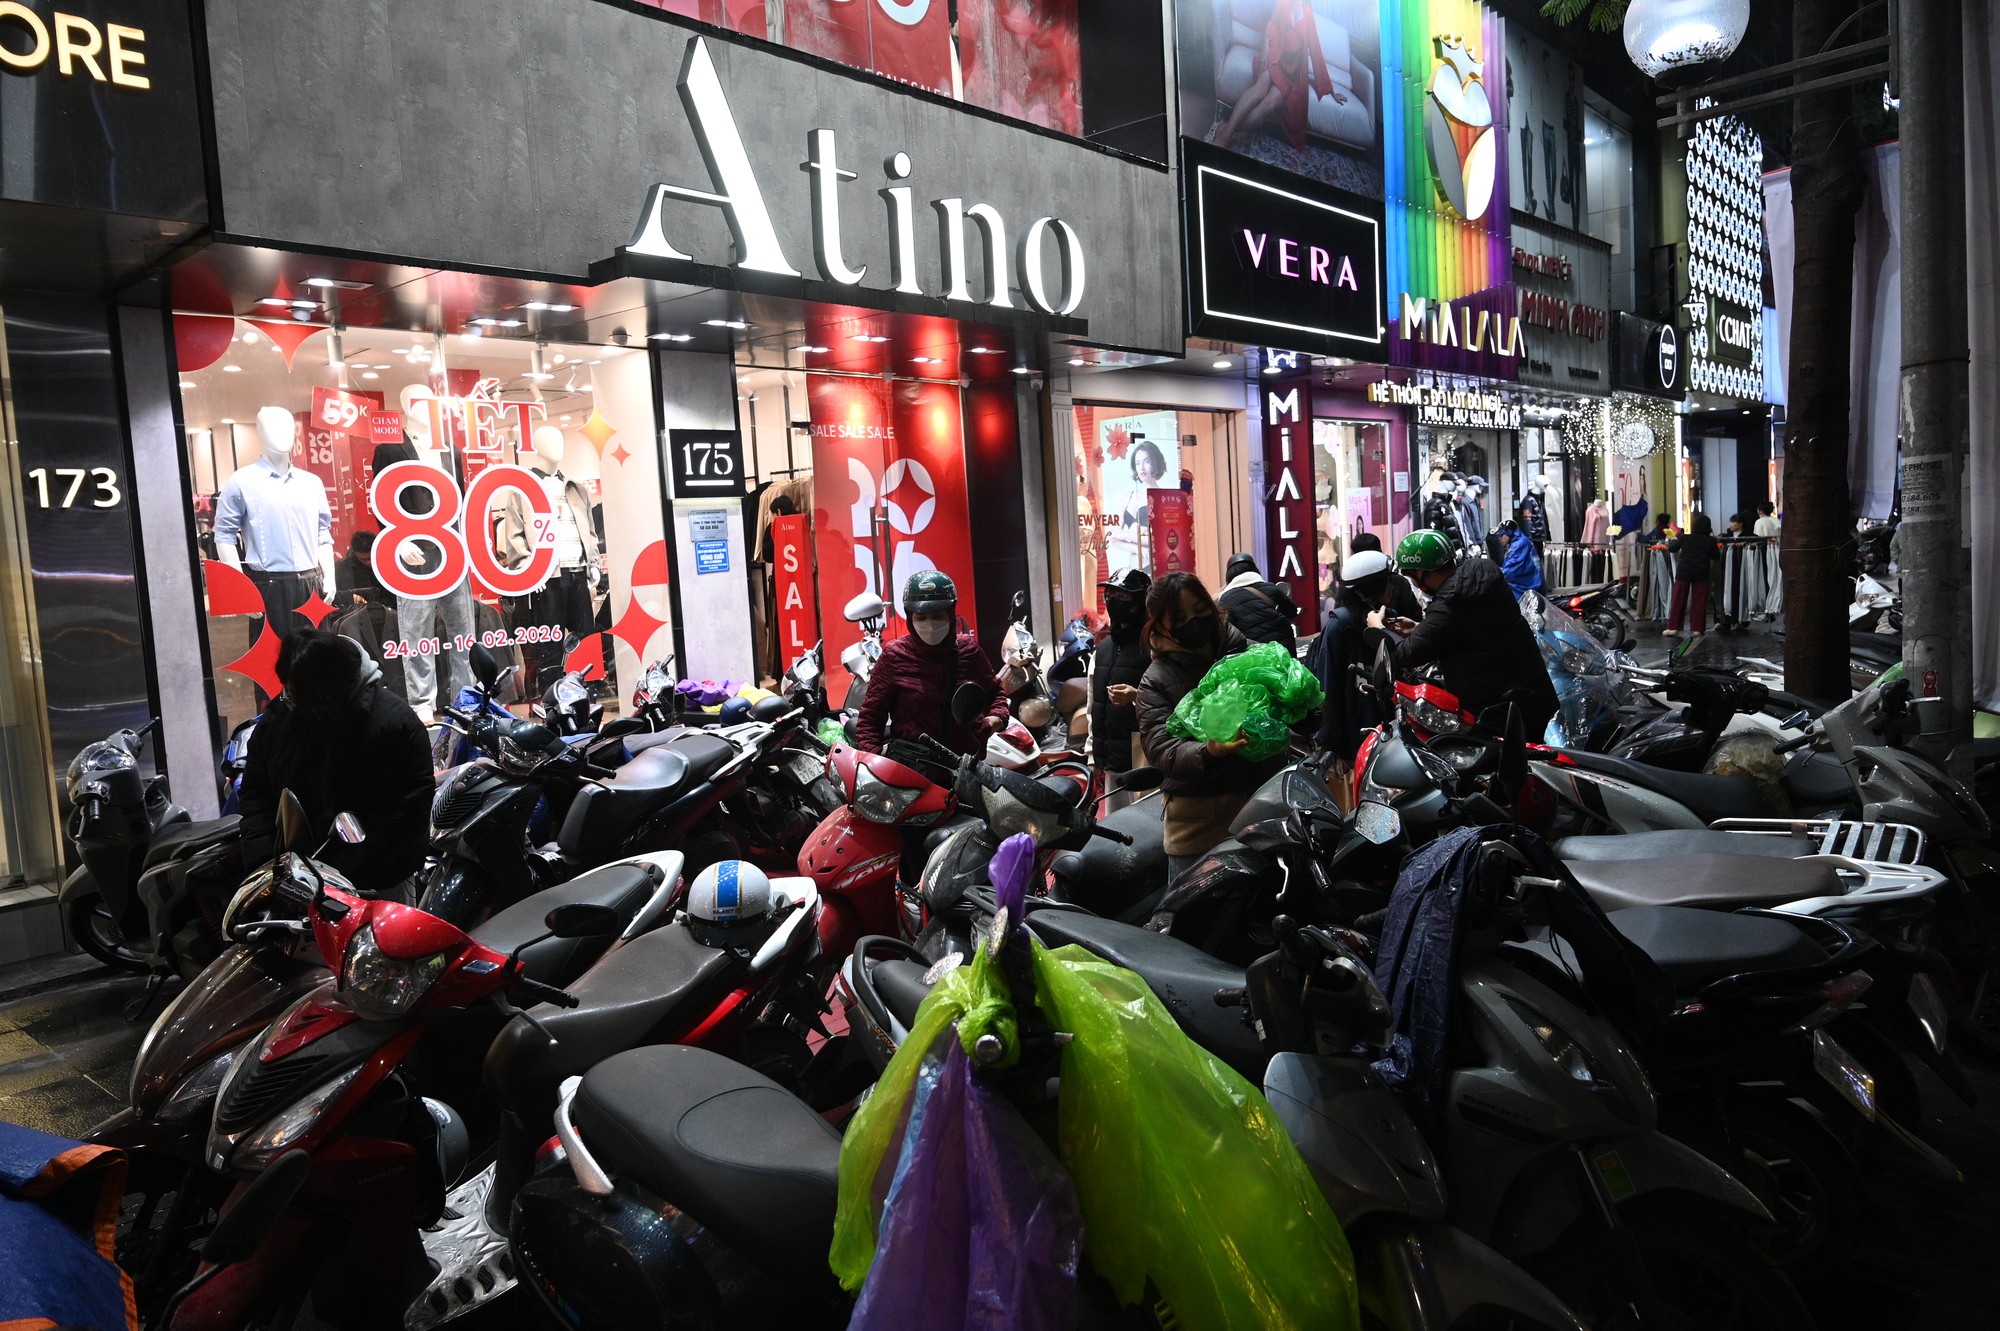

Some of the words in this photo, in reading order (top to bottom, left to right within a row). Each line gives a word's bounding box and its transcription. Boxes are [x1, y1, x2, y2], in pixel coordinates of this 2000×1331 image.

[0, 0, 150, 90] ORE
[626, 34, 1087, 316] Atino
[1243, 228, 1359, 292] VERA
[1519, 288, 1569, 331] MINH
[372, 416, 399, 426] CHAM
[373, 425, 400, 436] MODE
[407, 377, 548, 454] TẾT
[810, 424, 836, 438] SALE
[838, 424, 866, 438] SALE
[867, 426, 895, 439] SALE
[1104, 421, 1143, 432] VRA
[682, 442, 734, 475] 175
[28, 467, 121, 509] 173
[1094, 514, 1120, 527] YEAR
[1401, 554, 1422, 563] Grab
[783, 544, 804, 667] SAL
